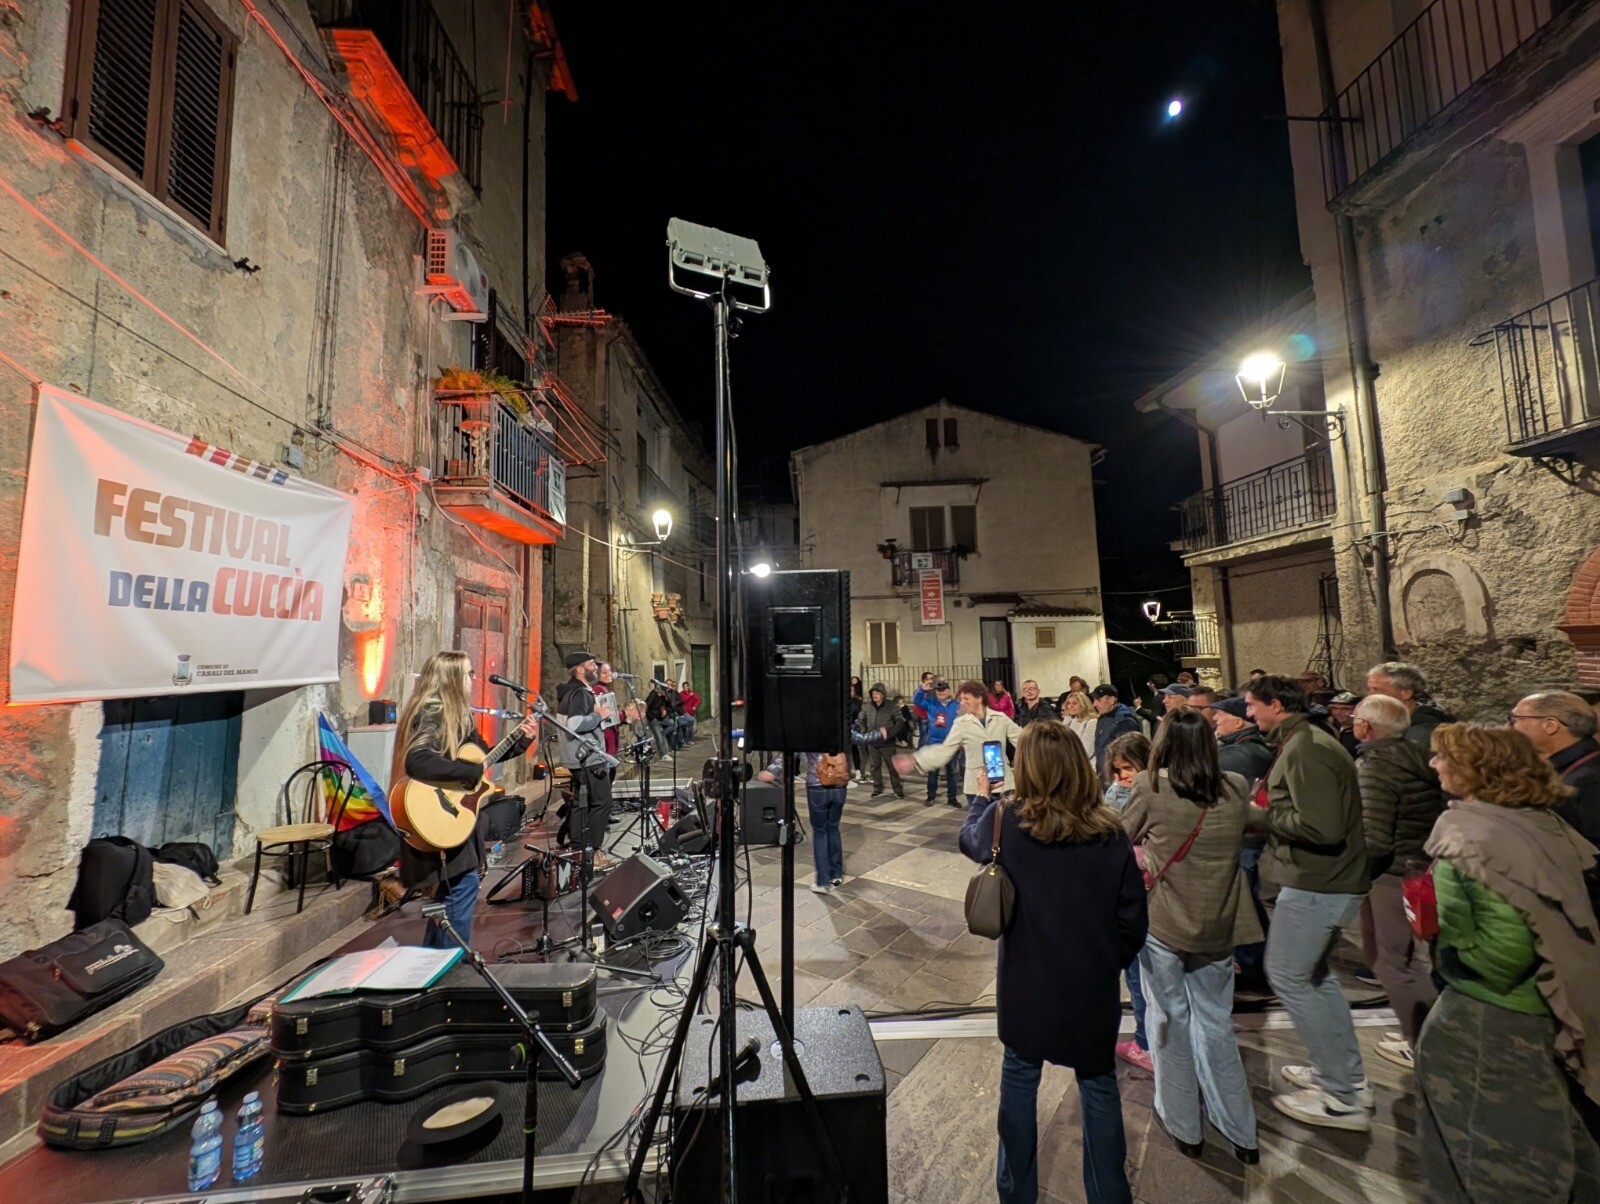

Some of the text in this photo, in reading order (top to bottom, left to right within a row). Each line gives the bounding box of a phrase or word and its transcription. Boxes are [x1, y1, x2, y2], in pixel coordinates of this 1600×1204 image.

[94, 478, 291, 567] FESTIVAL
[108, 567, 323, 621] DELLA CUCCÌA
